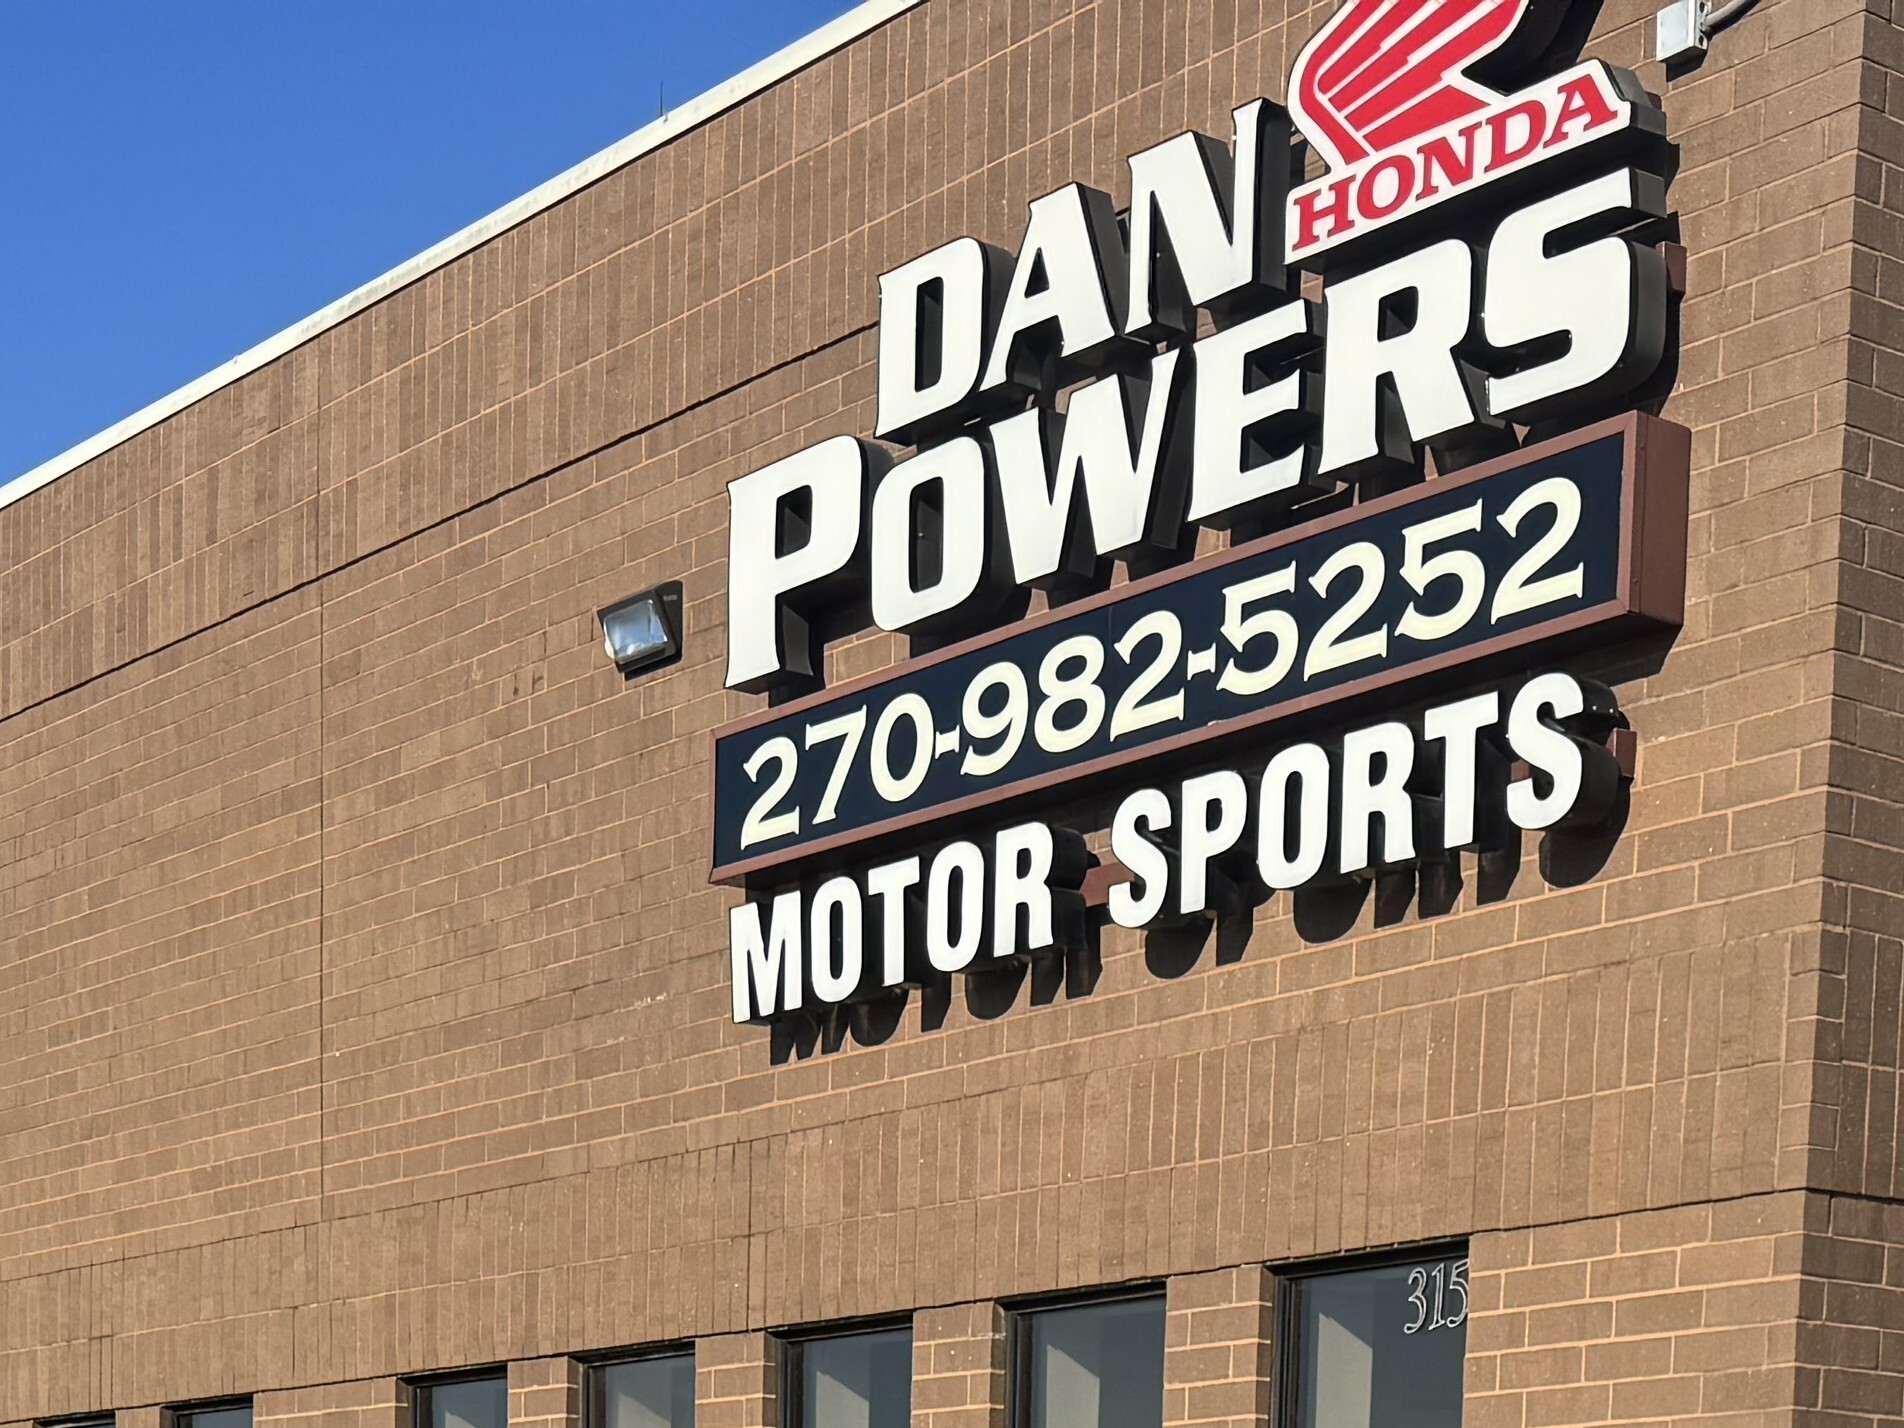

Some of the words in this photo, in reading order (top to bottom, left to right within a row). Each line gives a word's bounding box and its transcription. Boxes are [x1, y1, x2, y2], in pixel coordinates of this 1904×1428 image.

[876, 98, 1268, 440] DAN
[1292, 75, 1618, 253] HONDA
[724, 170, 1636, 691] POWERS
[739, 476, 1583, 851] 270-982-5252
[730, 821, 1055, 1024] MOTOR
[1108, 671, 1586, 929] SPORTS
[1403, 1258, 1469, 1334] 315
